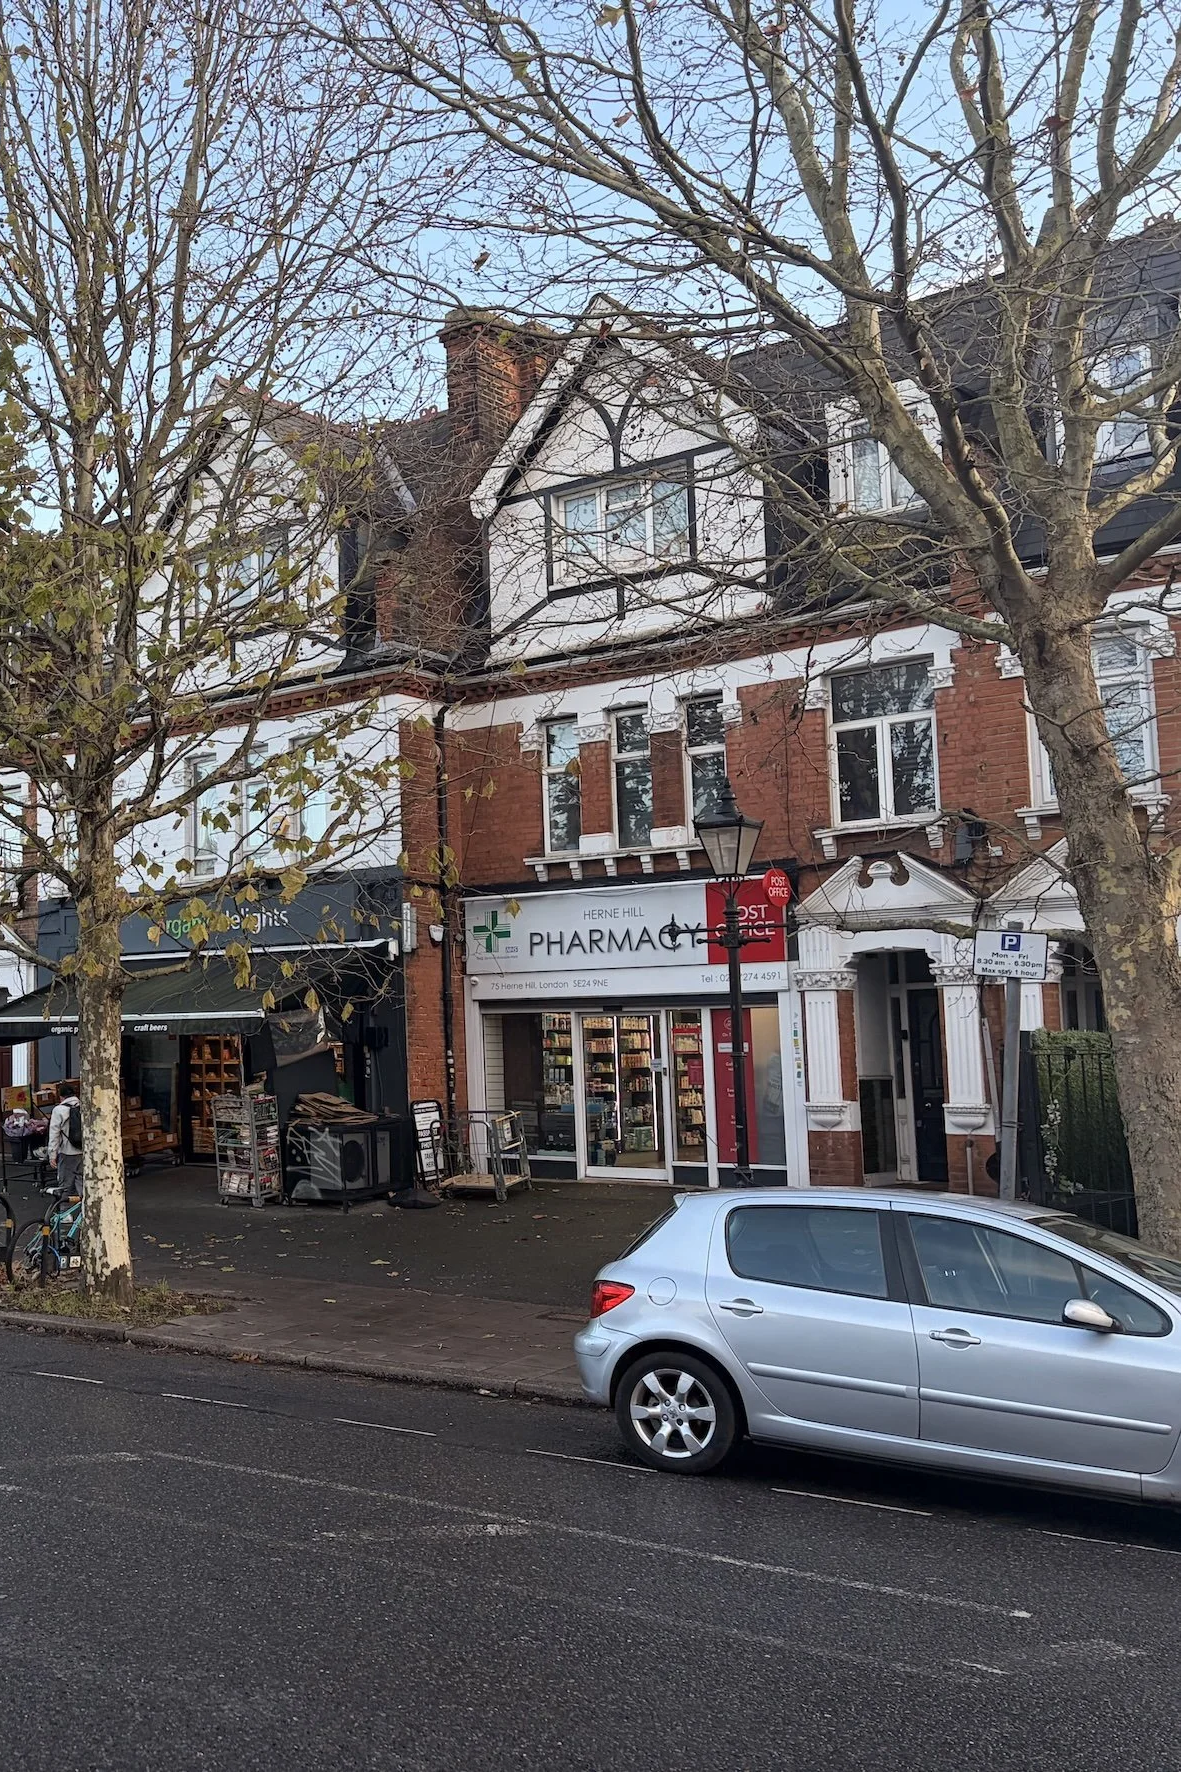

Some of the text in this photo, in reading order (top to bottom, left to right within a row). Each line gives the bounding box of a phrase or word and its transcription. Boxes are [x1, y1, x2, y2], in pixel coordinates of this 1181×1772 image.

[770, 876, 786, 887] POST
[768, 887, 789, 898] OFFICE
[583, 907, 644, 920] HERNE HILL
[736, 904, 769, 920] OST
[529, 922, 702, 956] PHARMACY
[701, 974, 713, 983] Tel
[740, 972, 759, 981] 274
[761, 970, 781, 980] 4591
[1020, 969, 1038, 977] hour
[491, 982, 500, 991] 75
[500, 982, 524, 991] Herne
[539, 980, 569, 989] London
[573, 979, 592, 988] SE24
[592, 978, 609, 987] 9NE
[51, 1025, 73, 1035] organic
[133, 1023, 149, 1032] craft
[149, 1023, 168, 1032] beers
